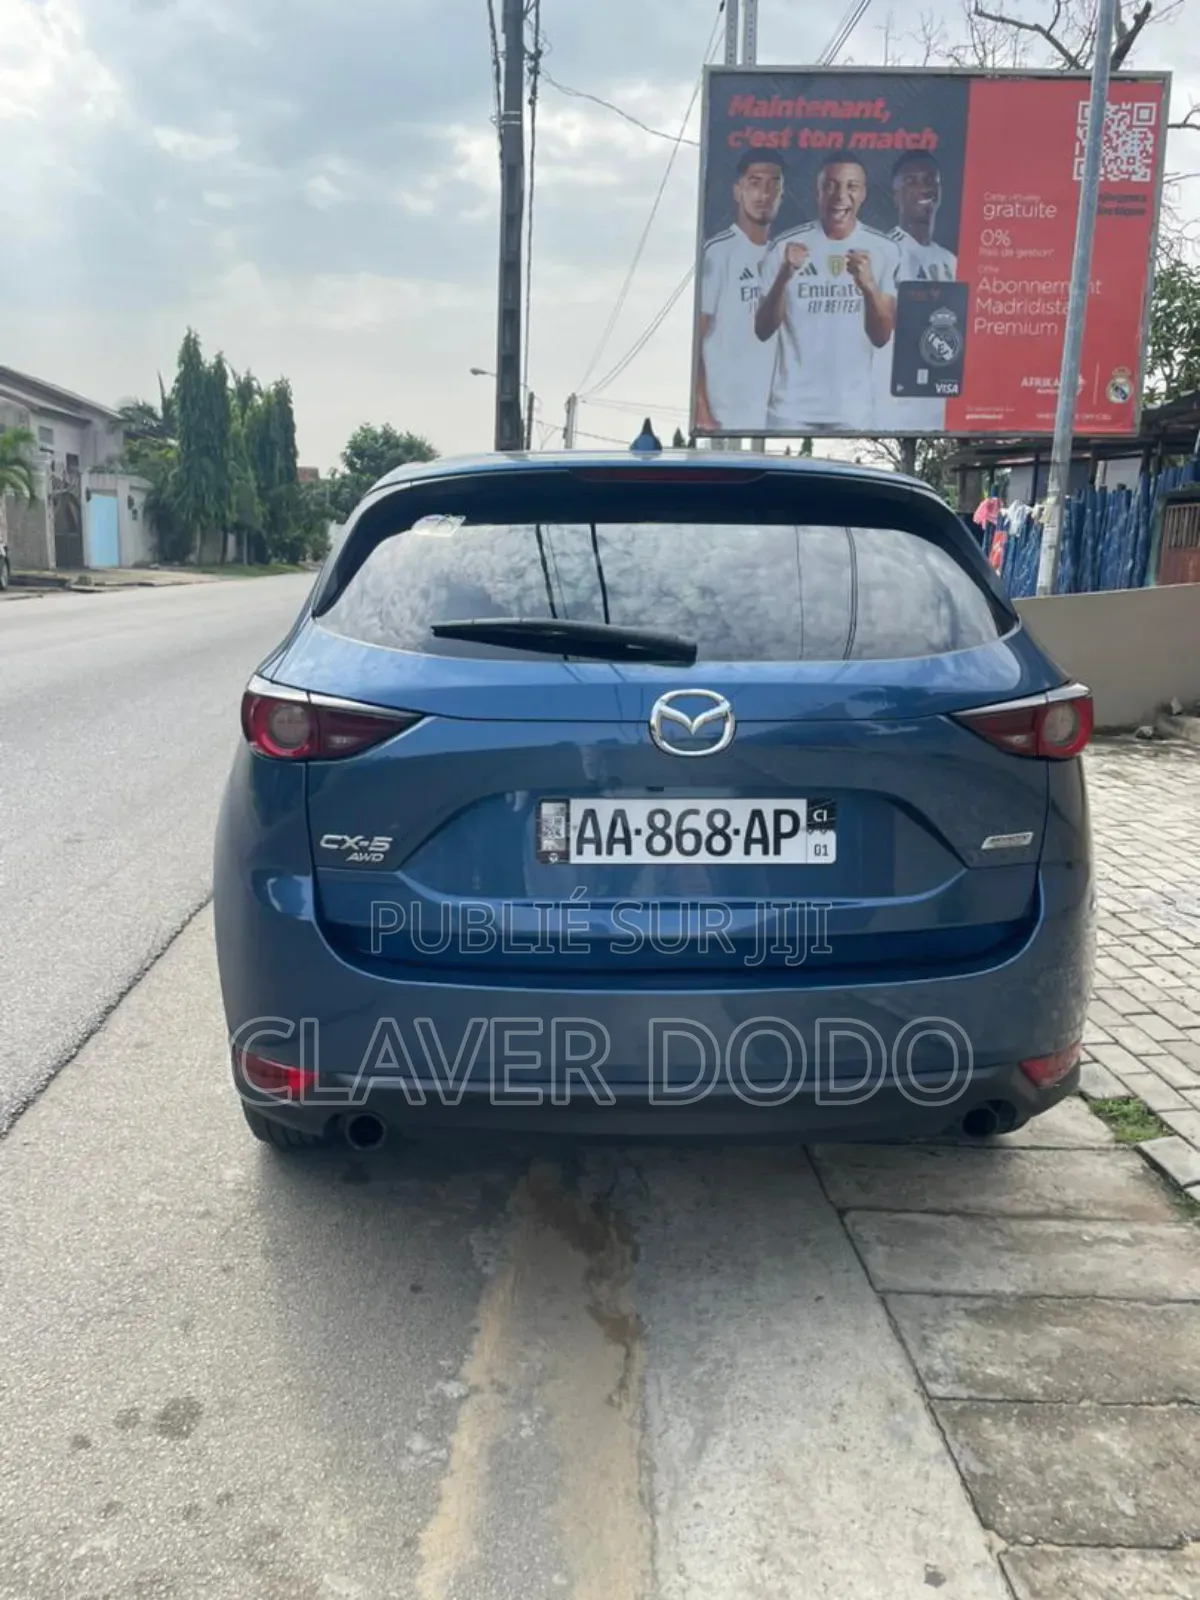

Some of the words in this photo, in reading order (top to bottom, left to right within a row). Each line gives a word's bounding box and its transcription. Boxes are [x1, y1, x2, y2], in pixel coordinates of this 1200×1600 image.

[729, 93, 891, 122] Maintenant,
[728, 126, 791, 148] c'est
[798, 127, 843, 148] ton
[849, 127, 938, 150] match
[983, 201, 1057, 220] gratuite
[980, 229, 1011, 246] 0%
[977, 276, 1102, 294] Abonnemnt
[974, 317, 1058, 336] Premium
[935, 383, 959, 394] VISA
[812, 809, 828, 822] CI
[320, 834, 393, 851] CX-5
[814, 843, 829, 856] 01
[346, 852, 384, 861] AWD
